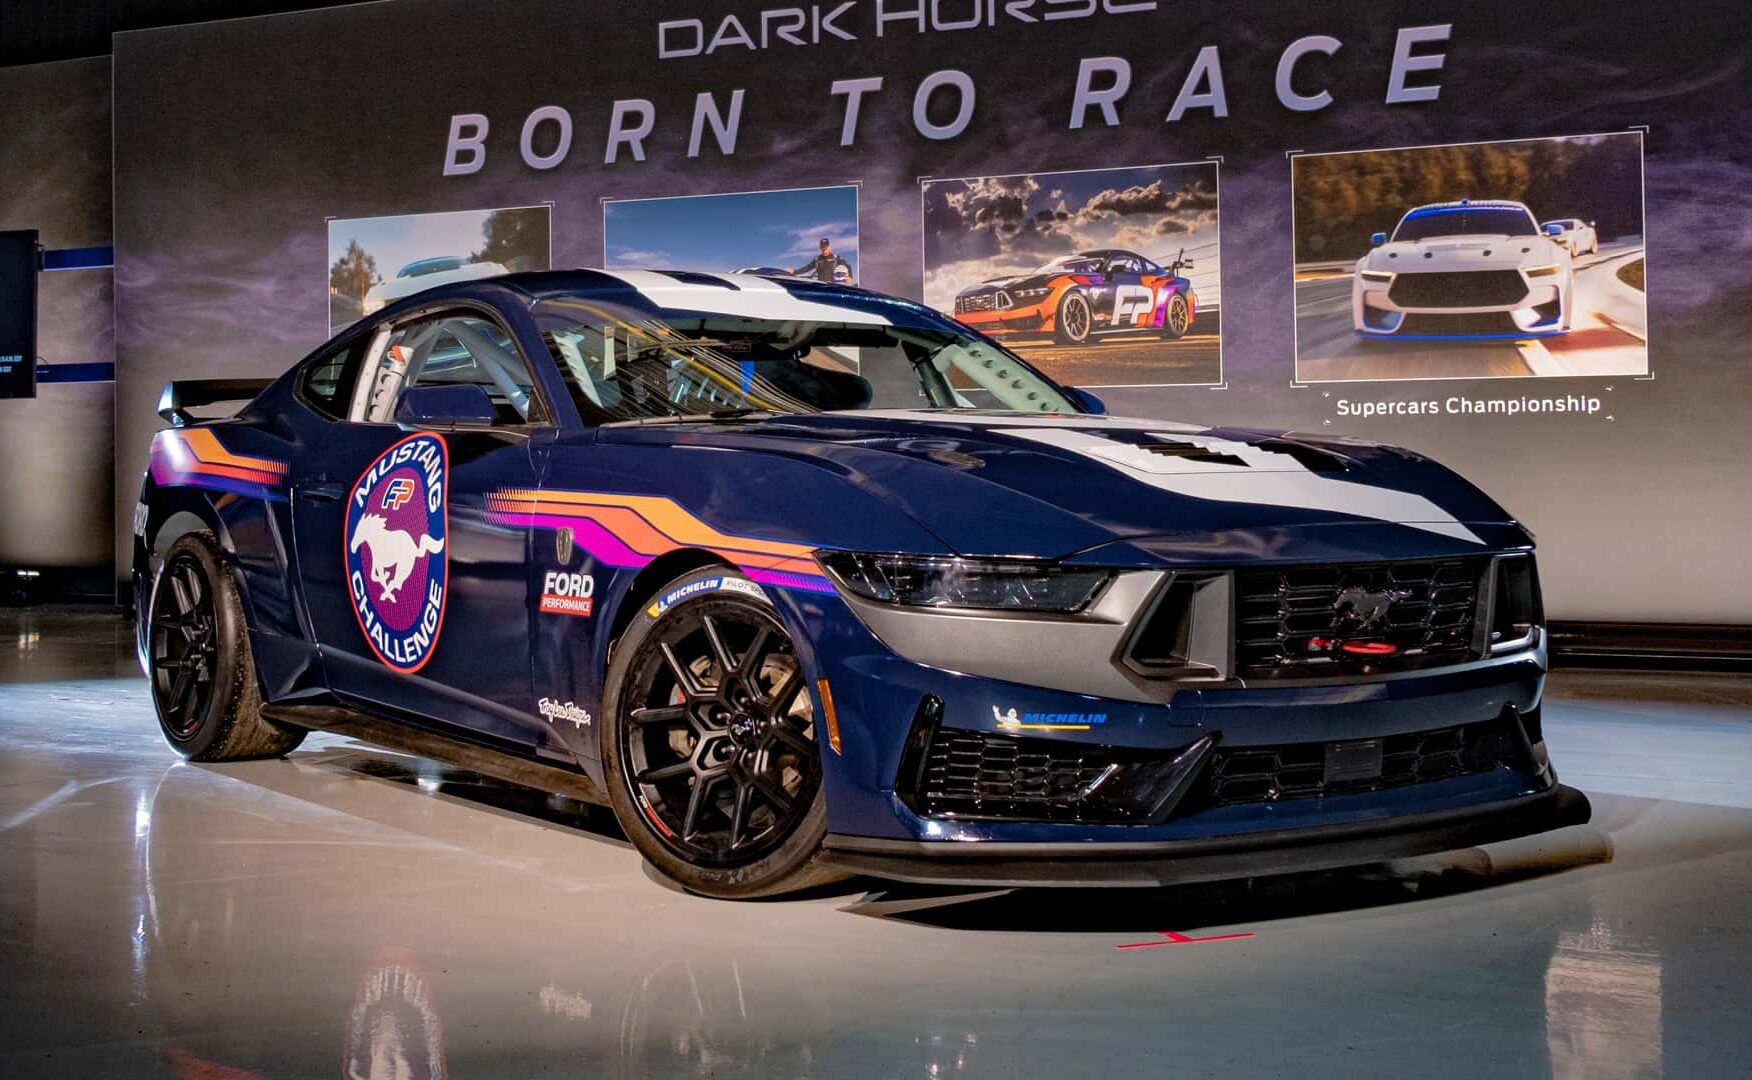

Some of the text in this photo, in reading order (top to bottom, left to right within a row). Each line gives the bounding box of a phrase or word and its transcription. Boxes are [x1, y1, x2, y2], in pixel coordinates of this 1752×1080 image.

[658, 0, 1157, 59] DARK HOR
[443, 23, 1453, 176] BORN TO RACE
[1336, 394, 1601, 418] Supercars Championship
[354, 440, 442, 513] MUSTANG
[544, 571, 595, 598] FORD
[666, 579, 719, 604] MICHELIN
[351, 569, 443, 663] CHALLENGE
[542, 597, 591, 612] PERFORMANCE
[1023, 713, 1107, 725] MICHELIN
